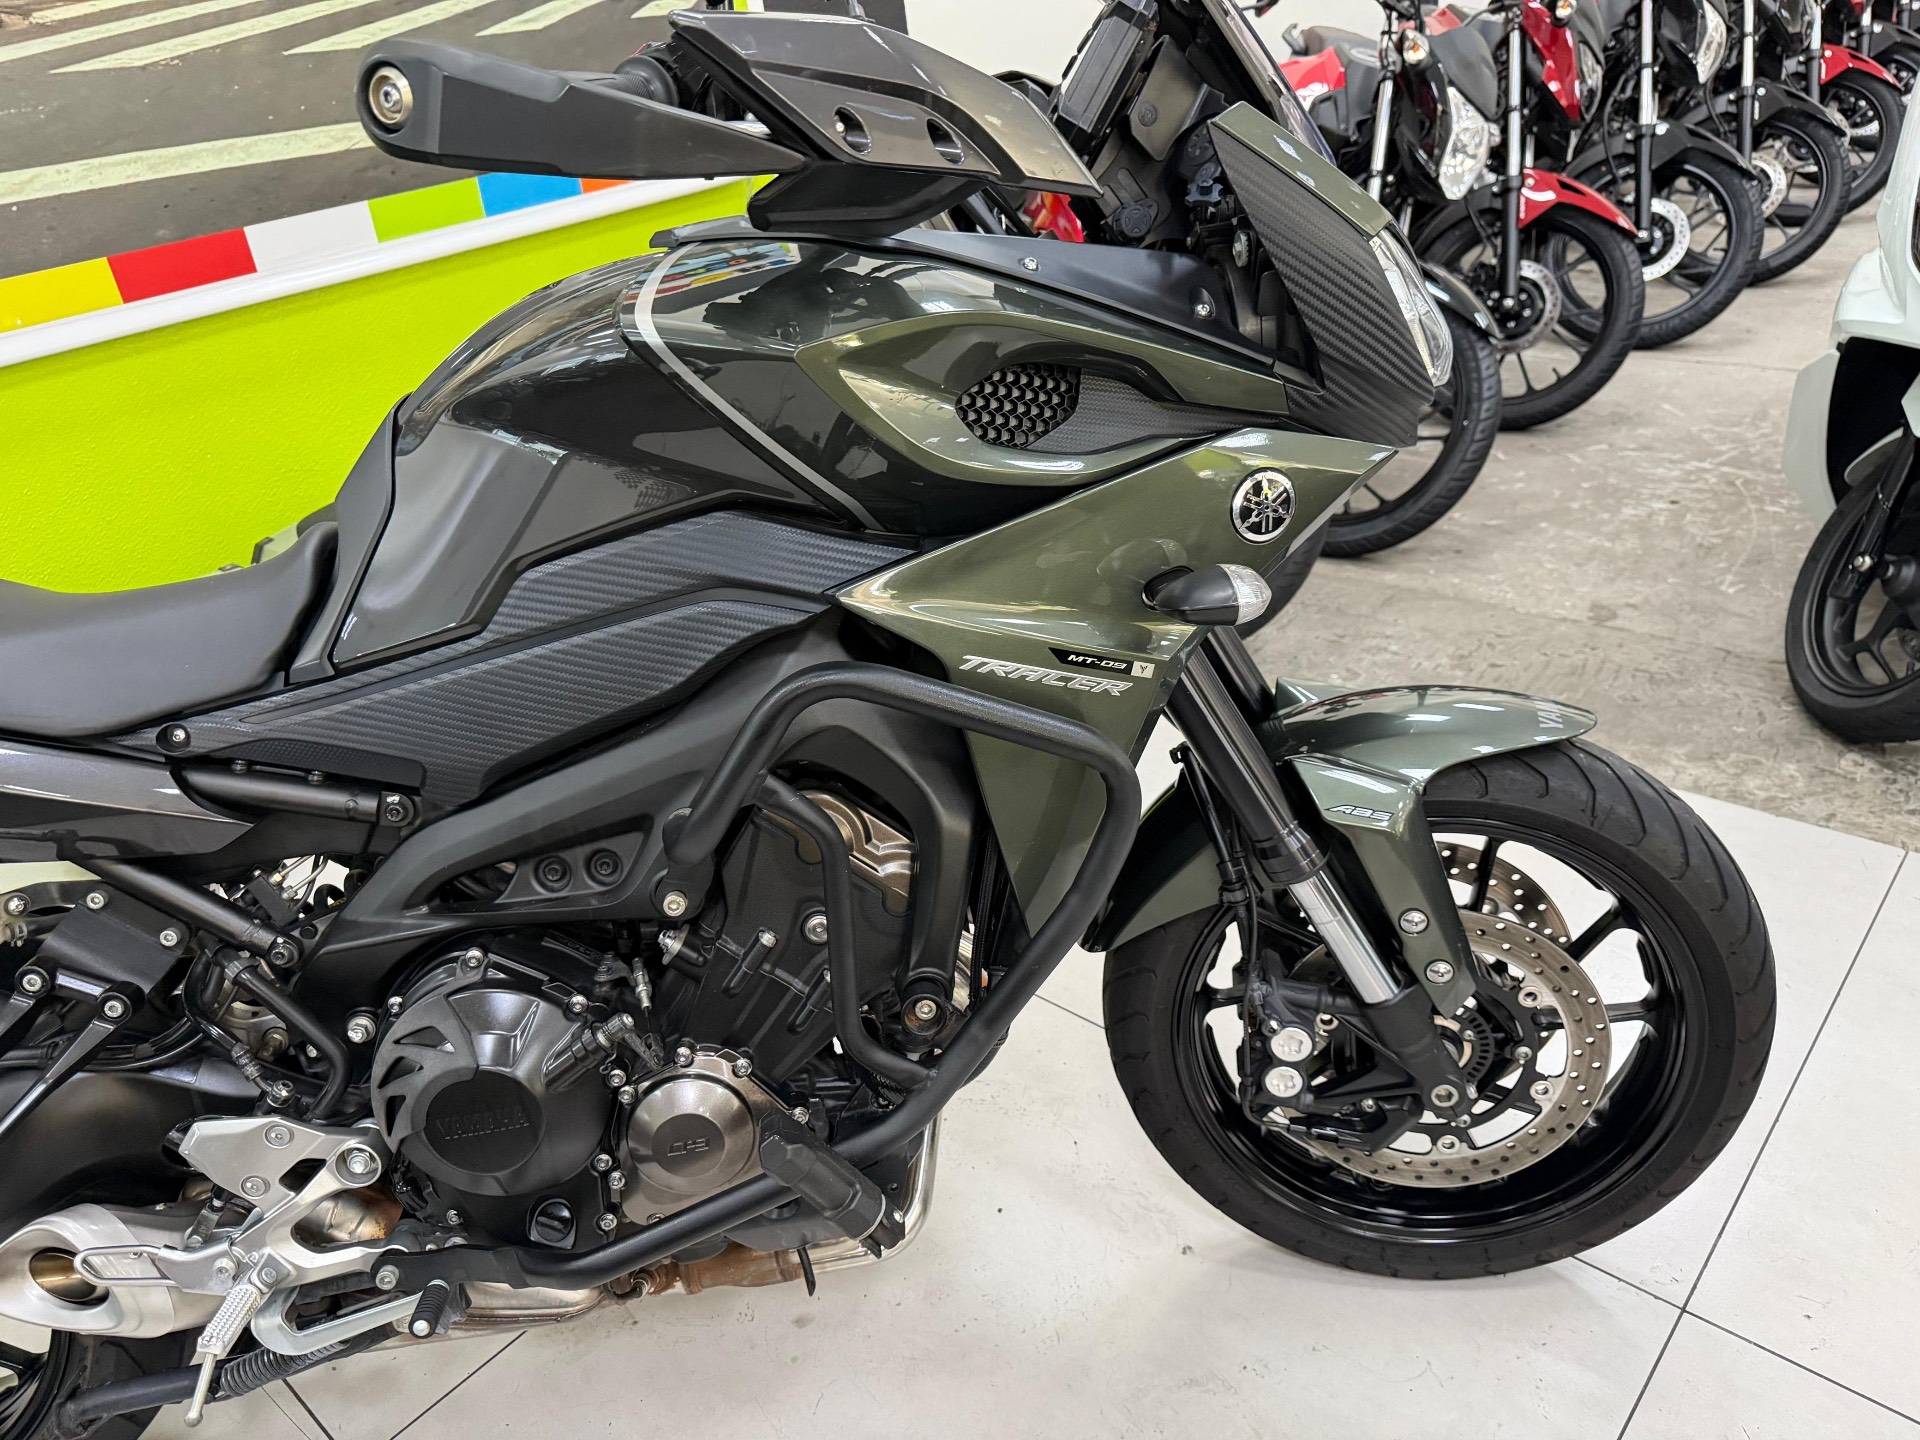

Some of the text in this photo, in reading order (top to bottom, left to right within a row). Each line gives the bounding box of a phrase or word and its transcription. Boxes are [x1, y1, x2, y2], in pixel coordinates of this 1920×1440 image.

[1067, 654, 1127, 670] MT-09
[958, 654, 1134, 697] TRACER
[1324, 804, 1394, 821] ABS
[435, 1104, 531, 1140] YAMAHA
